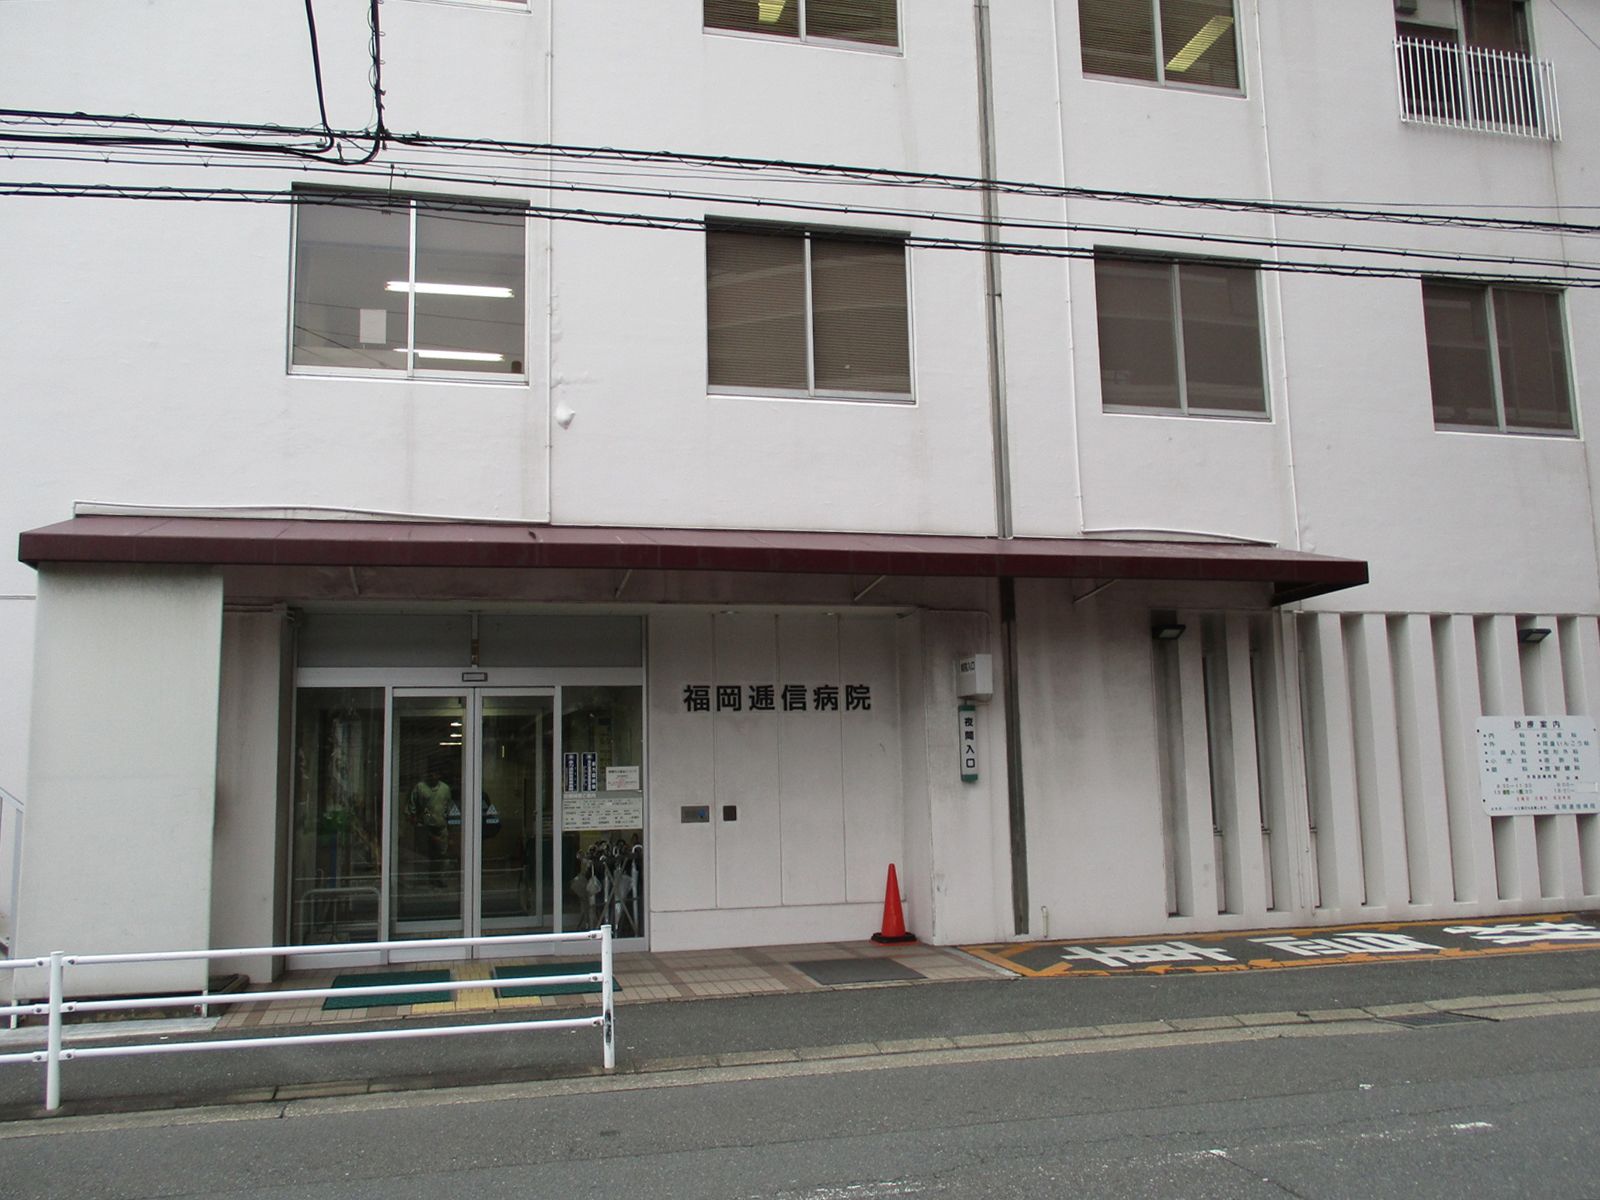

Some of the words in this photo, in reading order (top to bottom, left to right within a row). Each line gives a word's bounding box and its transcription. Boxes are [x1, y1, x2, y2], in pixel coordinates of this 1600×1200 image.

[683, 684, 872, 712] 福岡逓信病院
[1514, 720, 1561, 729] 診療案内
[964, 717, 976, 768] 夜間入口
